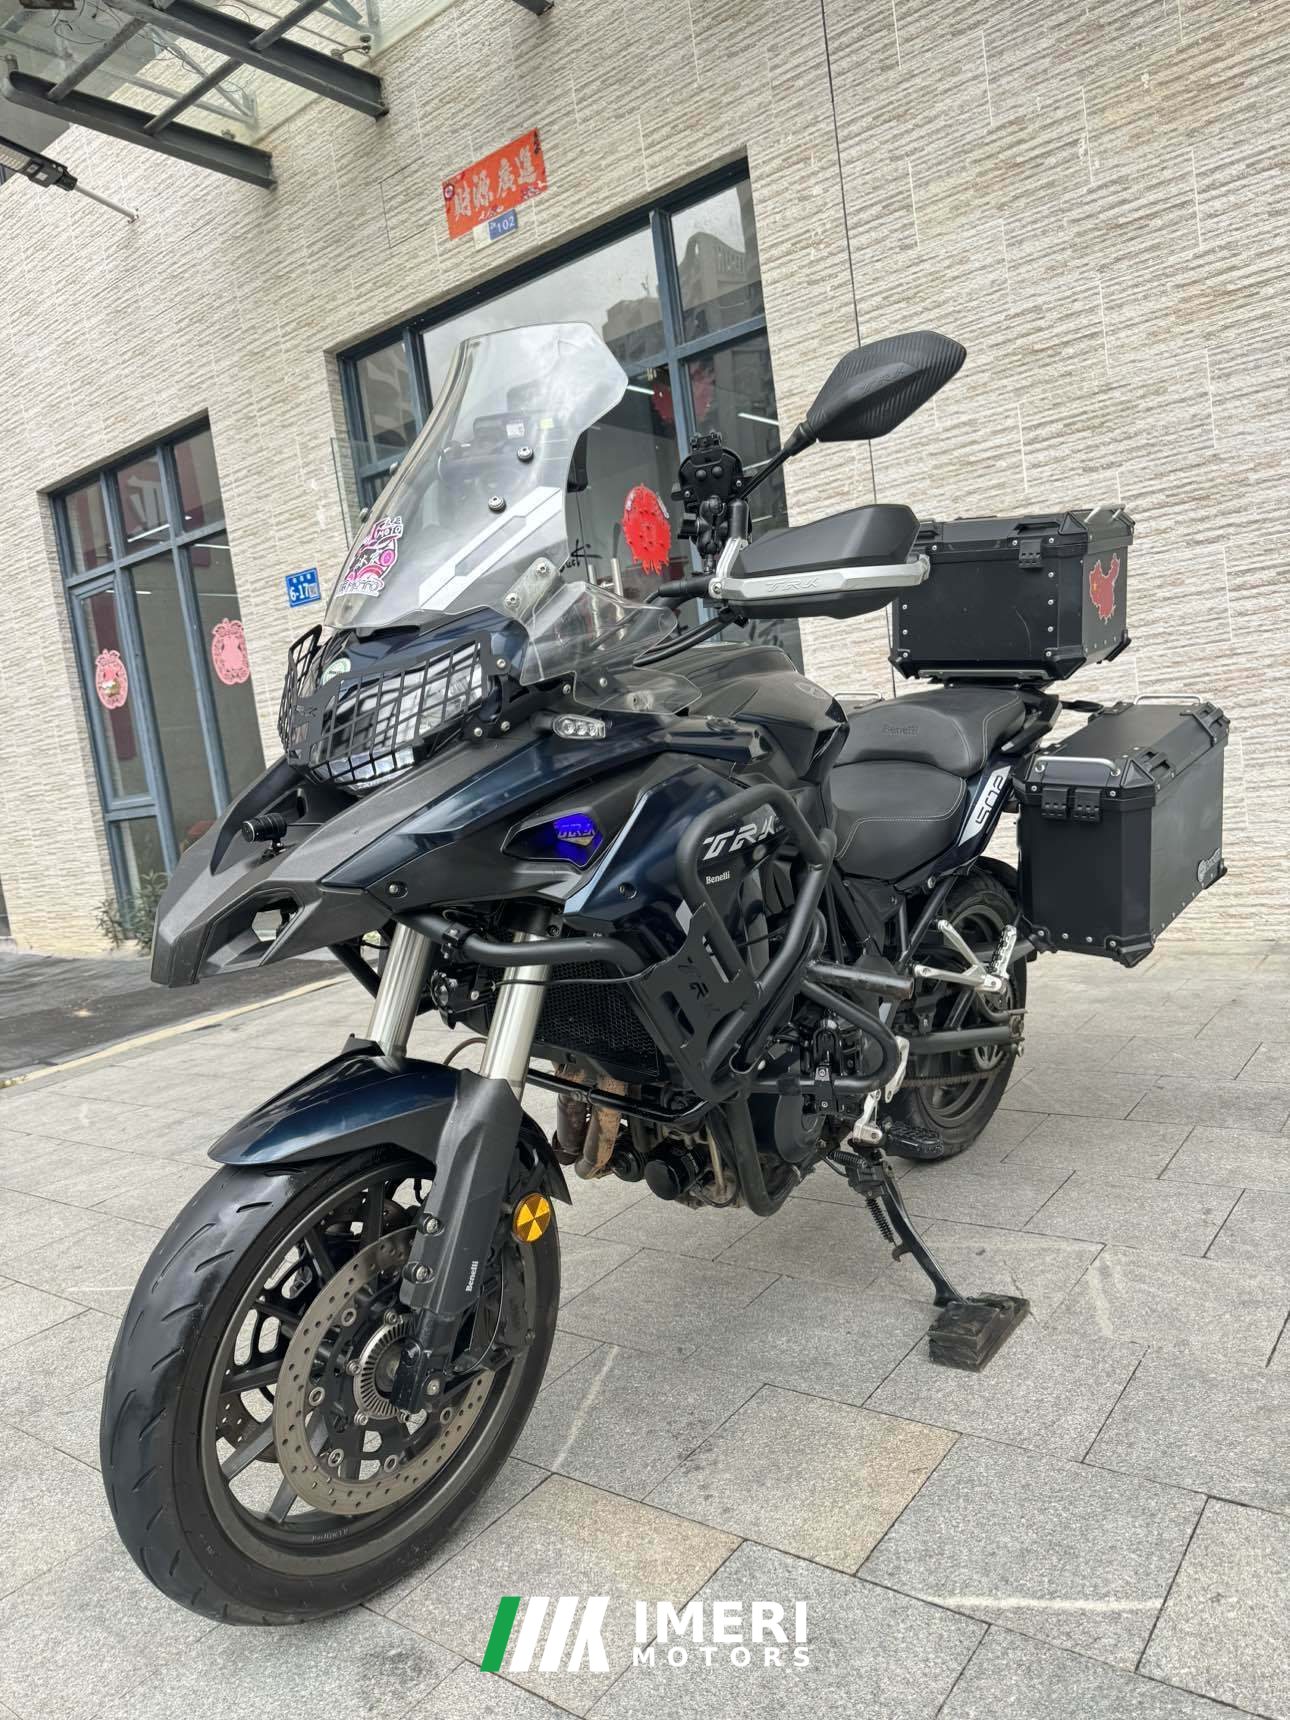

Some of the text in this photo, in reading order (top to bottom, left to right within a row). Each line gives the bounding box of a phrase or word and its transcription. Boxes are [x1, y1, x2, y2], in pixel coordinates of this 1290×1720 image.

[702, 815, 775, 861] TRK
[705, 871, 730, 885] Benelli
[465, 1260, 479, 1292] Benelli
